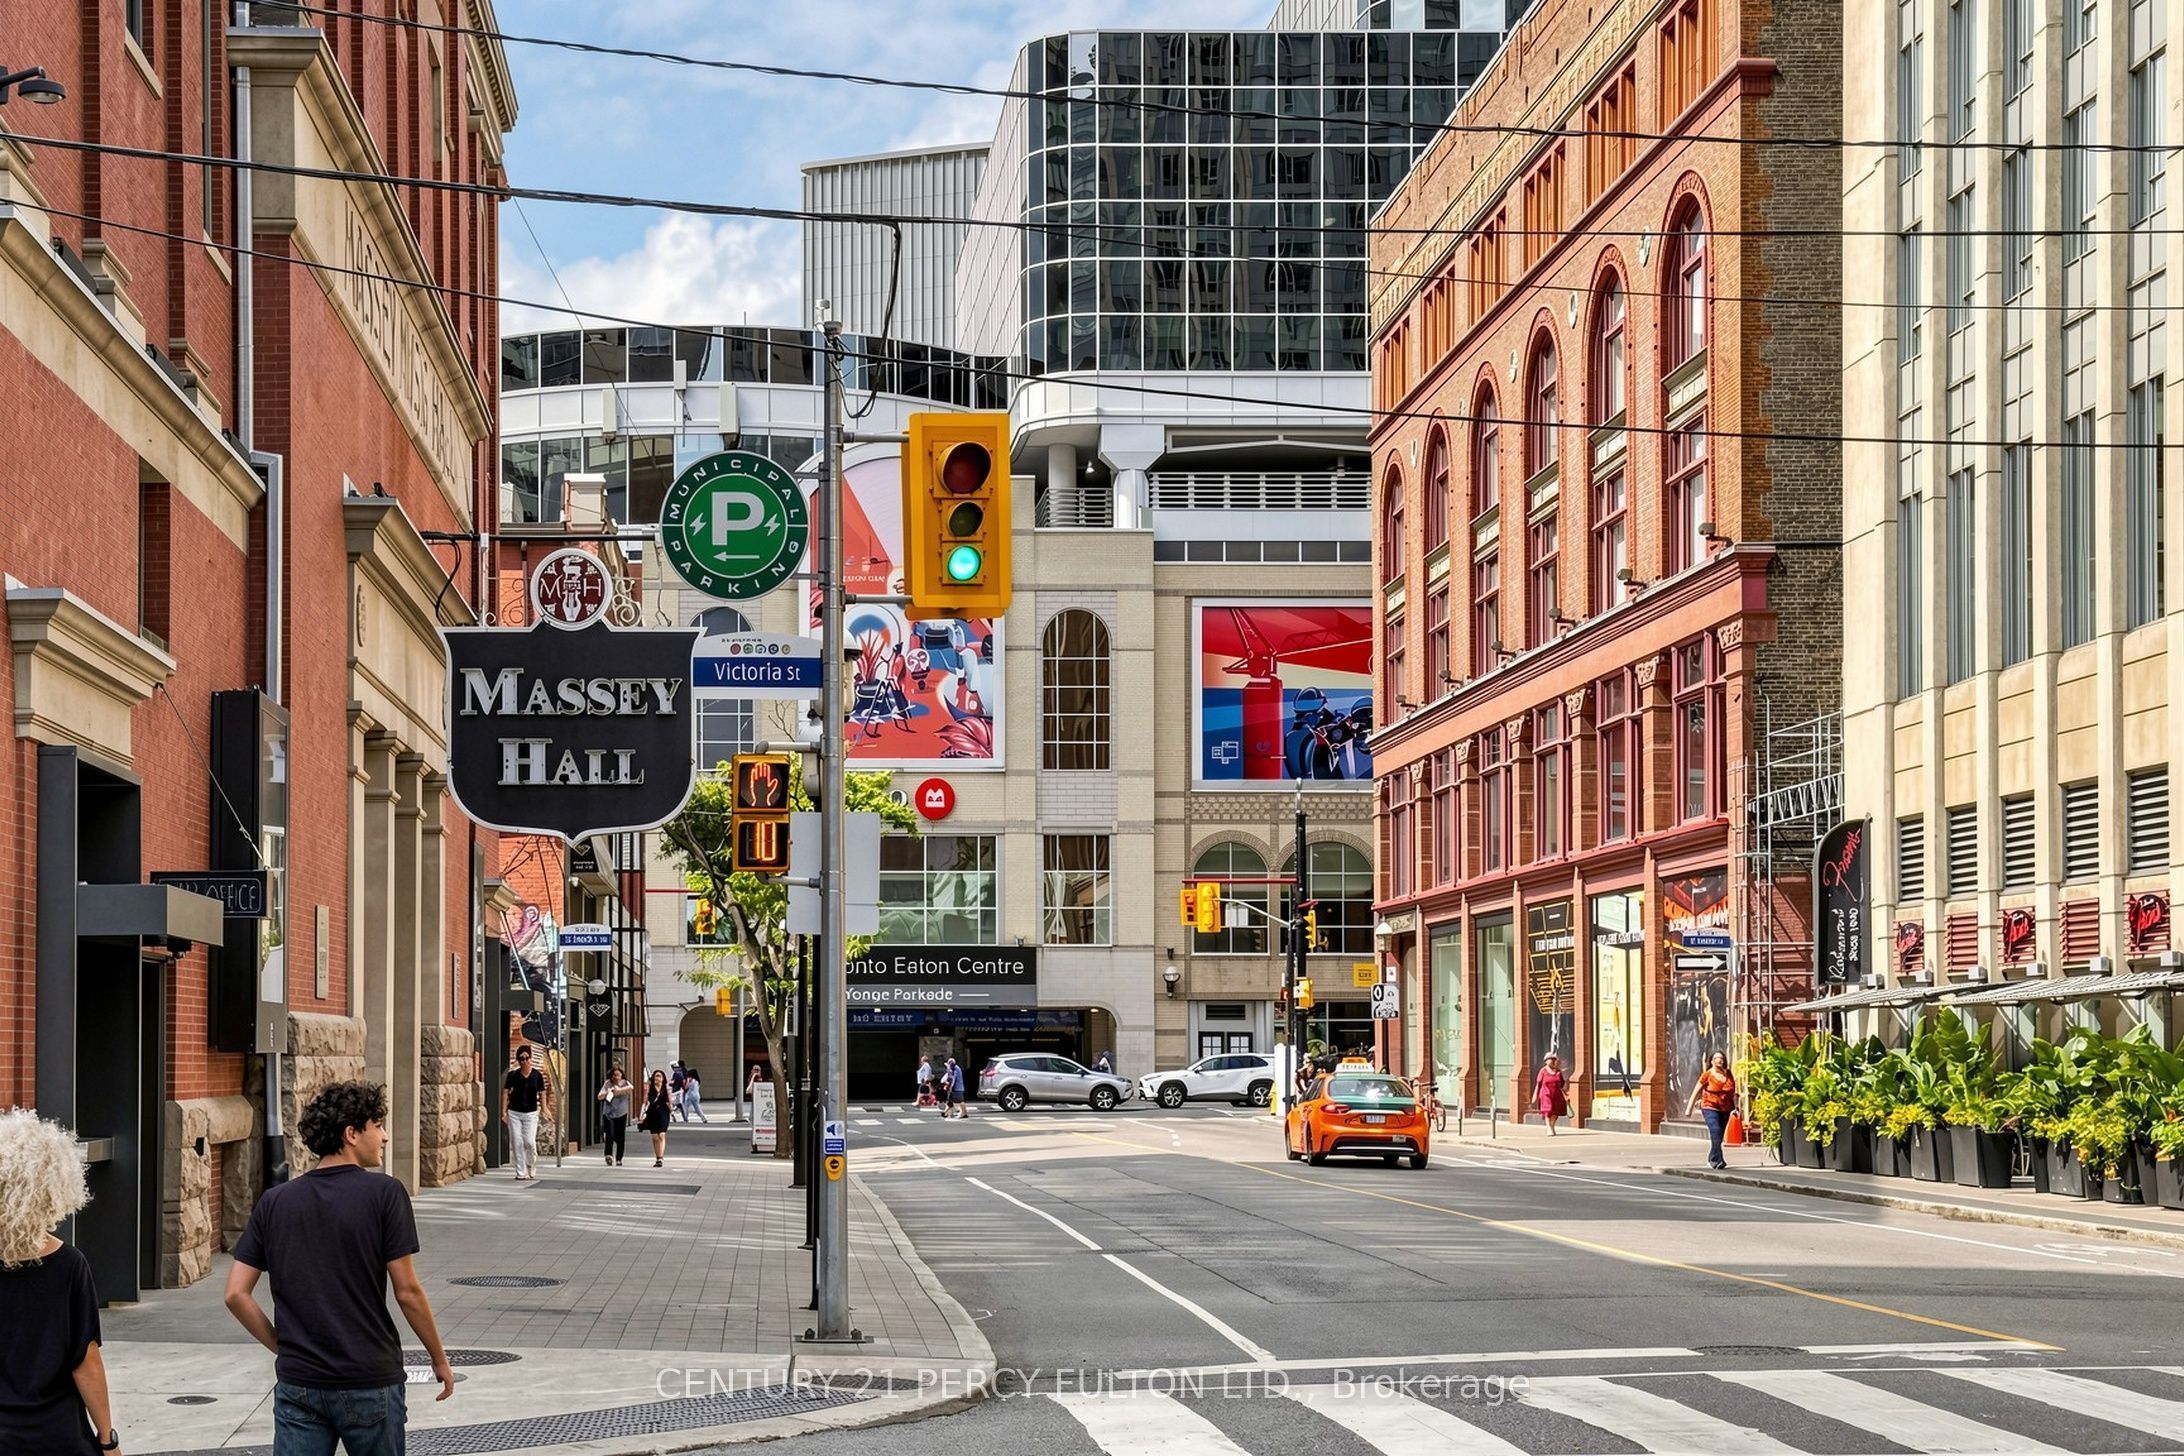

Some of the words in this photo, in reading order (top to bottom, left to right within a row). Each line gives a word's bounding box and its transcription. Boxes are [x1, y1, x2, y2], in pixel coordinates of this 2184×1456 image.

[669, 459, 799, 520] MUNICIPAL
[711, 491, 766, 546] P
[670, 540, 799, 594] PARKING
[459, 667, 683, 716] MASSEY
[714, 662, 782, 681] Victoria
[787, 665, 801, 681] St
[497, 737, 645, 786] HALL
[894, 956, 950, 975] Eaton
[957, 956, 1025, 975] Centre
[846, 987, 891, 1003] Yonge
